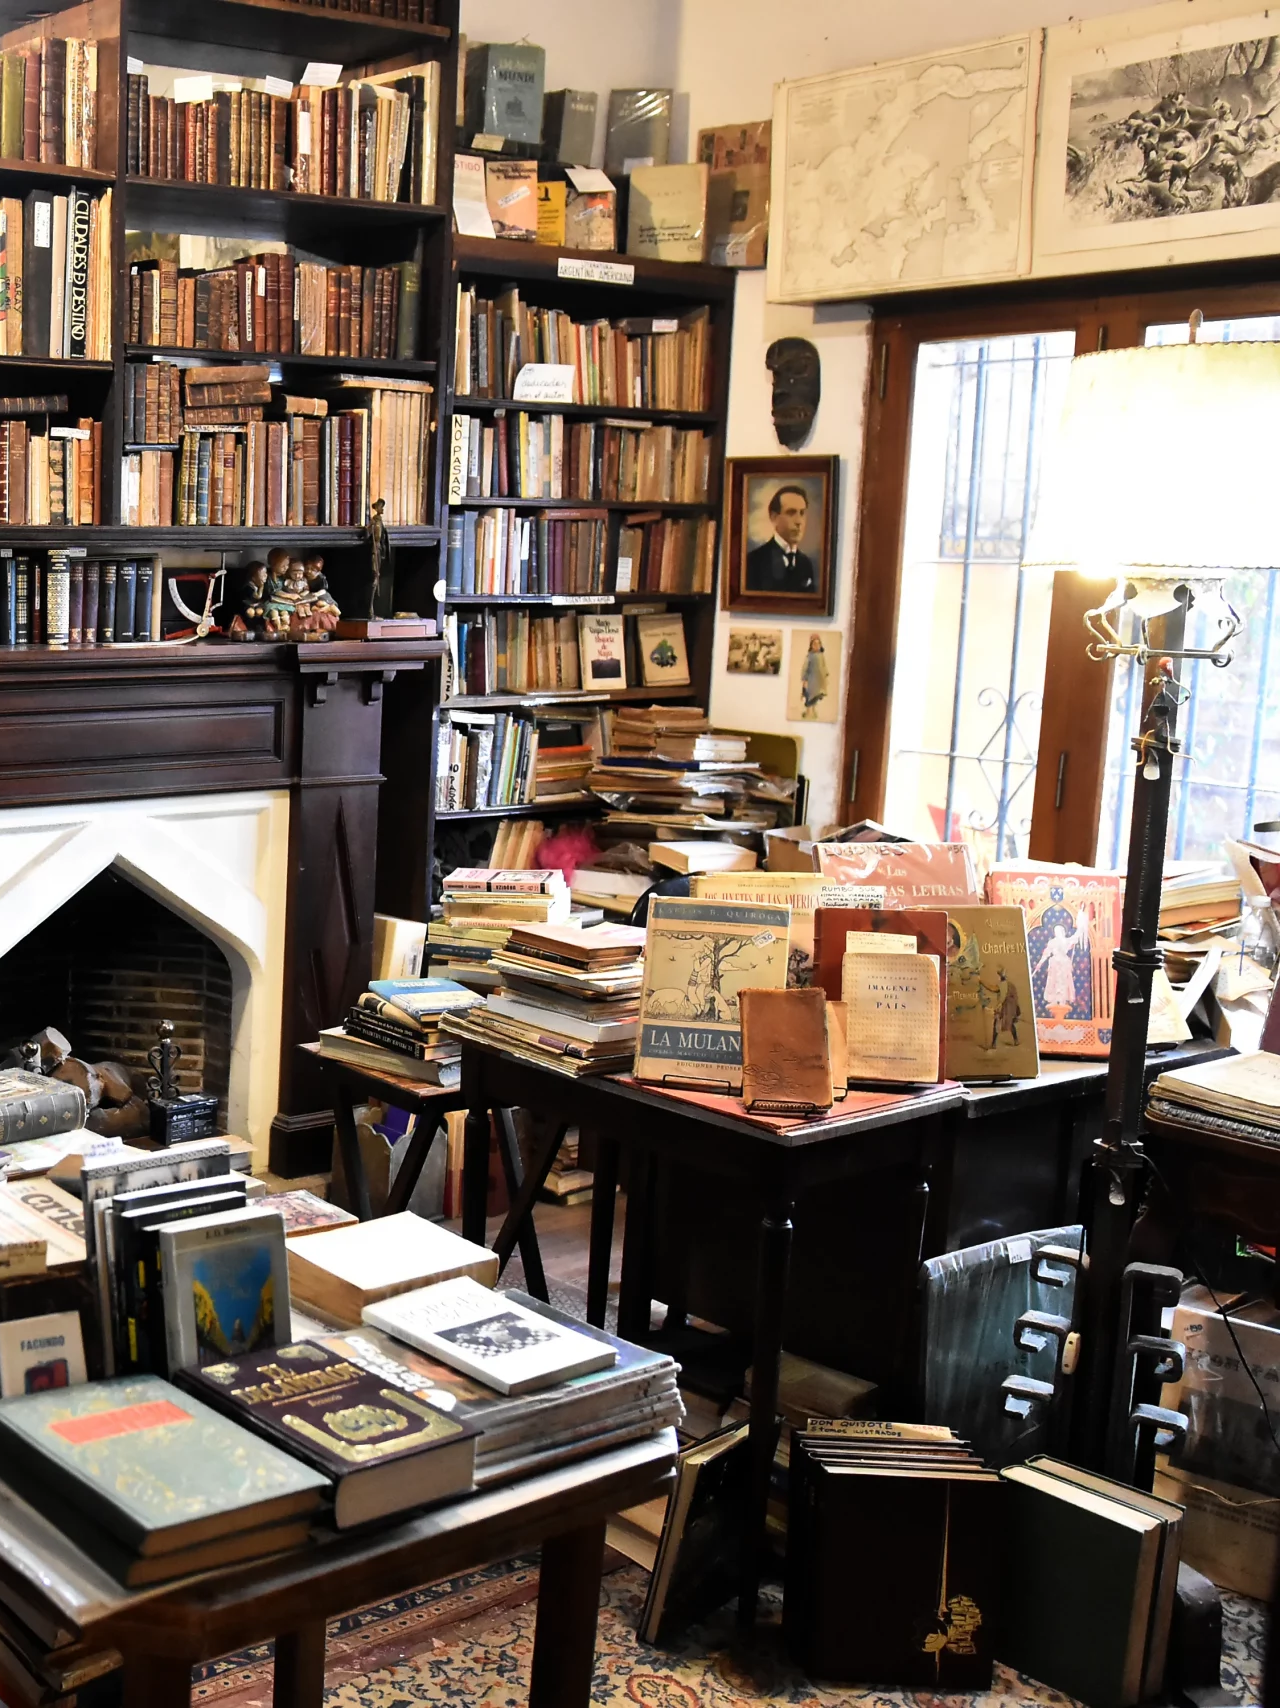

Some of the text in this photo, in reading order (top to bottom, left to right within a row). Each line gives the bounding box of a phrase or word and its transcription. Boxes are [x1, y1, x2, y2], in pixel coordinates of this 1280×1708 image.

[69, 199, 90, 341] CIUDADES DESTINO
[449, 445, 463, 496] PASAR
[886, 864, 908, 878] Las
[912, 883, 965, 898] LETRAS
[781, 893, 821, 910] AMERICA
[726, 909, 782, 923] QUIROGA
[981, 941, 1015, 955] Charles
[867, 983, 917, 993] IMAGENES
[884, 993, 899, 1001] DEL
[875, 1001, 907, 1012] PAIS
[650, 1028, 741, 1052] LA MULAN
[20, 1335, 66, 1352] FACUNDO
[256, 1362, 296, 1380] EL
[810, 1420, 894, 1432] DON QUIJOTE
[851, 1429, 903, 1438] ILUSTRADOS
